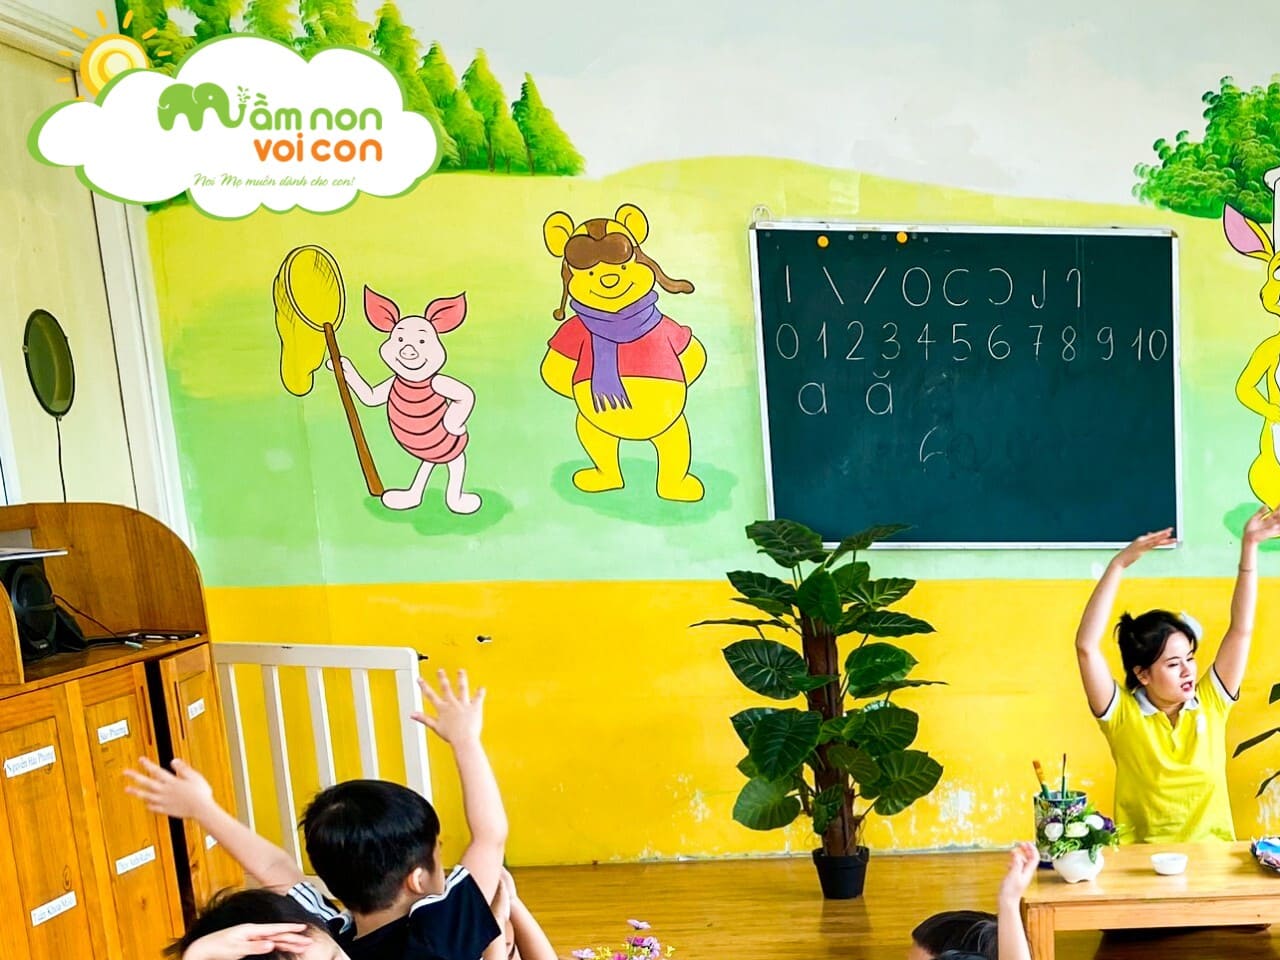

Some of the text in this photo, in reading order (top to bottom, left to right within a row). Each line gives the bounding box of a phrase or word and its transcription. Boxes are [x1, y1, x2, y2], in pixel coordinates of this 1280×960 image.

[775, 321, 1167, 361] 0 1 2 3 4 5 6 7 8 9 10
[798, 382, 828, 415] a
